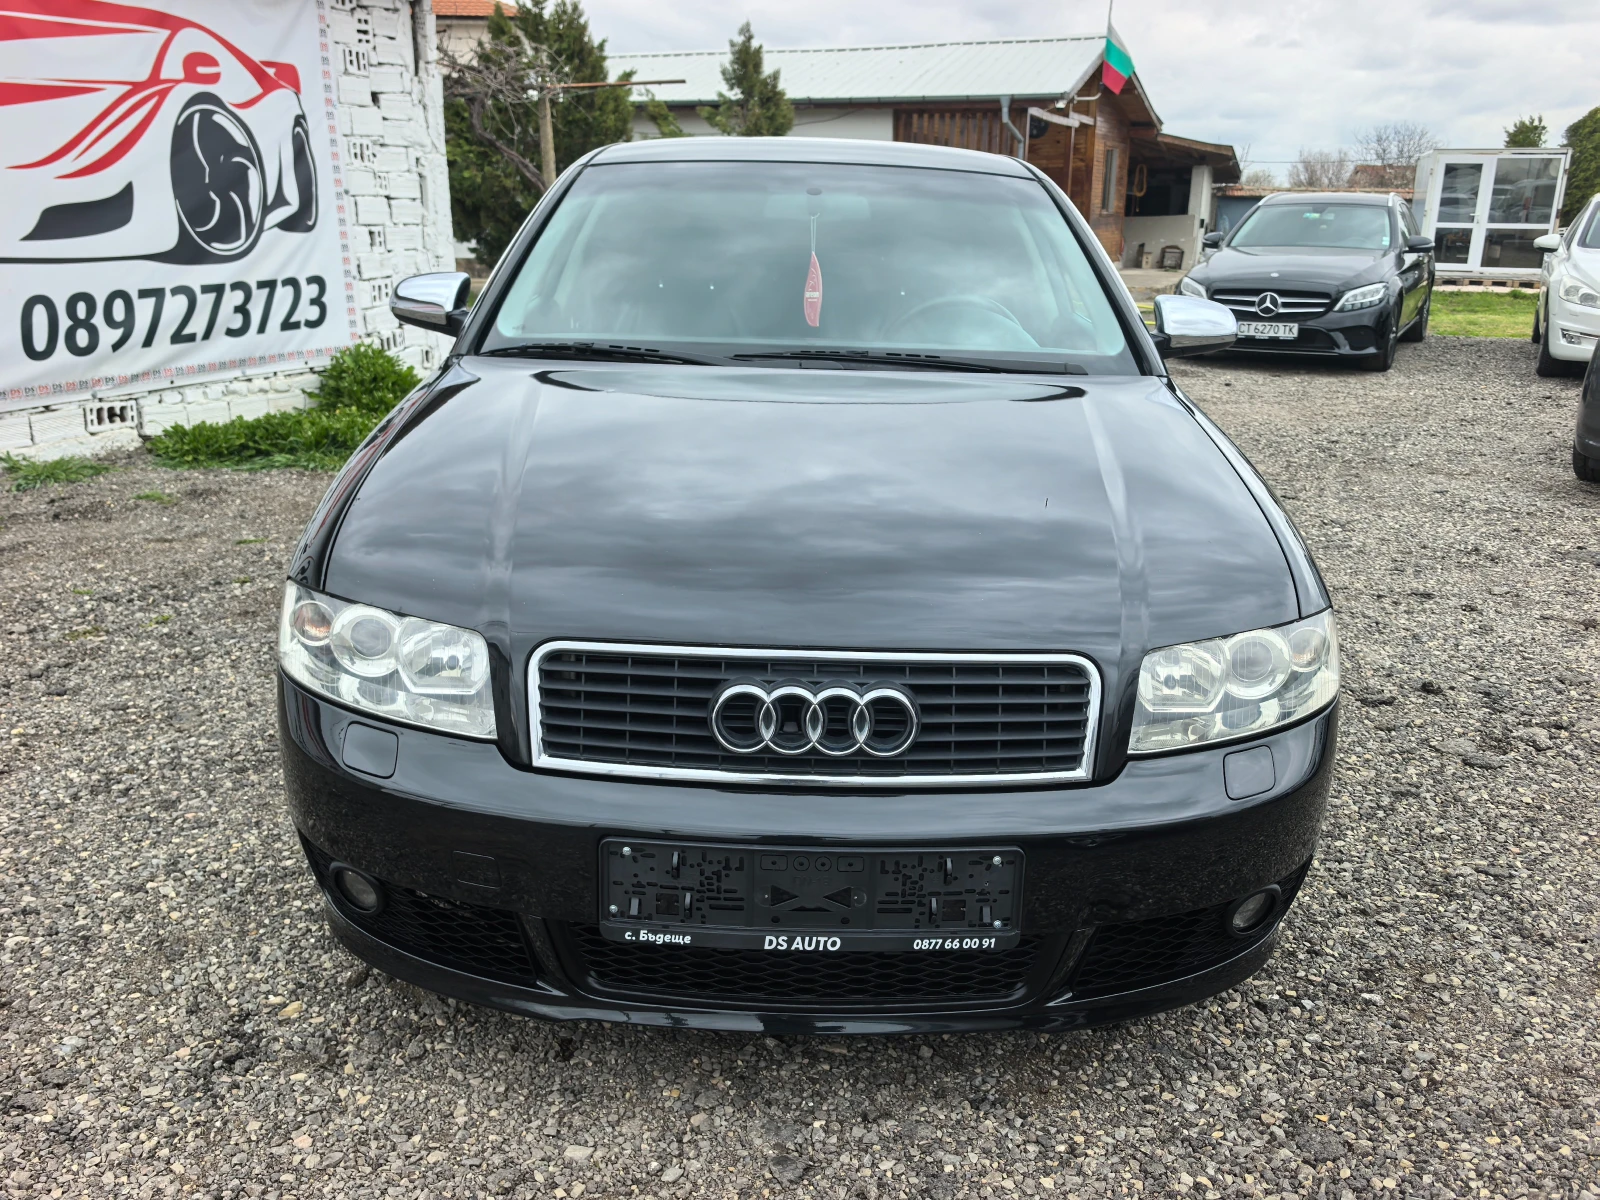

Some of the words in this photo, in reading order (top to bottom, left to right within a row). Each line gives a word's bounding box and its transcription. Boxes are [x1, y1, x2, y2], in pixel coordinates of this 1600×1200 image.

[20, 275, 328, 361] 0897273723
[1238, 322, 1253, 334] CT
[1253, 323, 1280, 335] 6270
[1281, 324, 1297, 336] TK
[624, 931, 636, 940] с.
[639, 929, 692, 945] Бъдеще
[763, 935, 789, 950] DS
[790, 936, 842, 951] AUTO
[913, 938, 943, 950] 0877
[944, 938, 960, 949] 66
[962, 937, 980, 949] 00
[982, 937, 996, 949] 91
